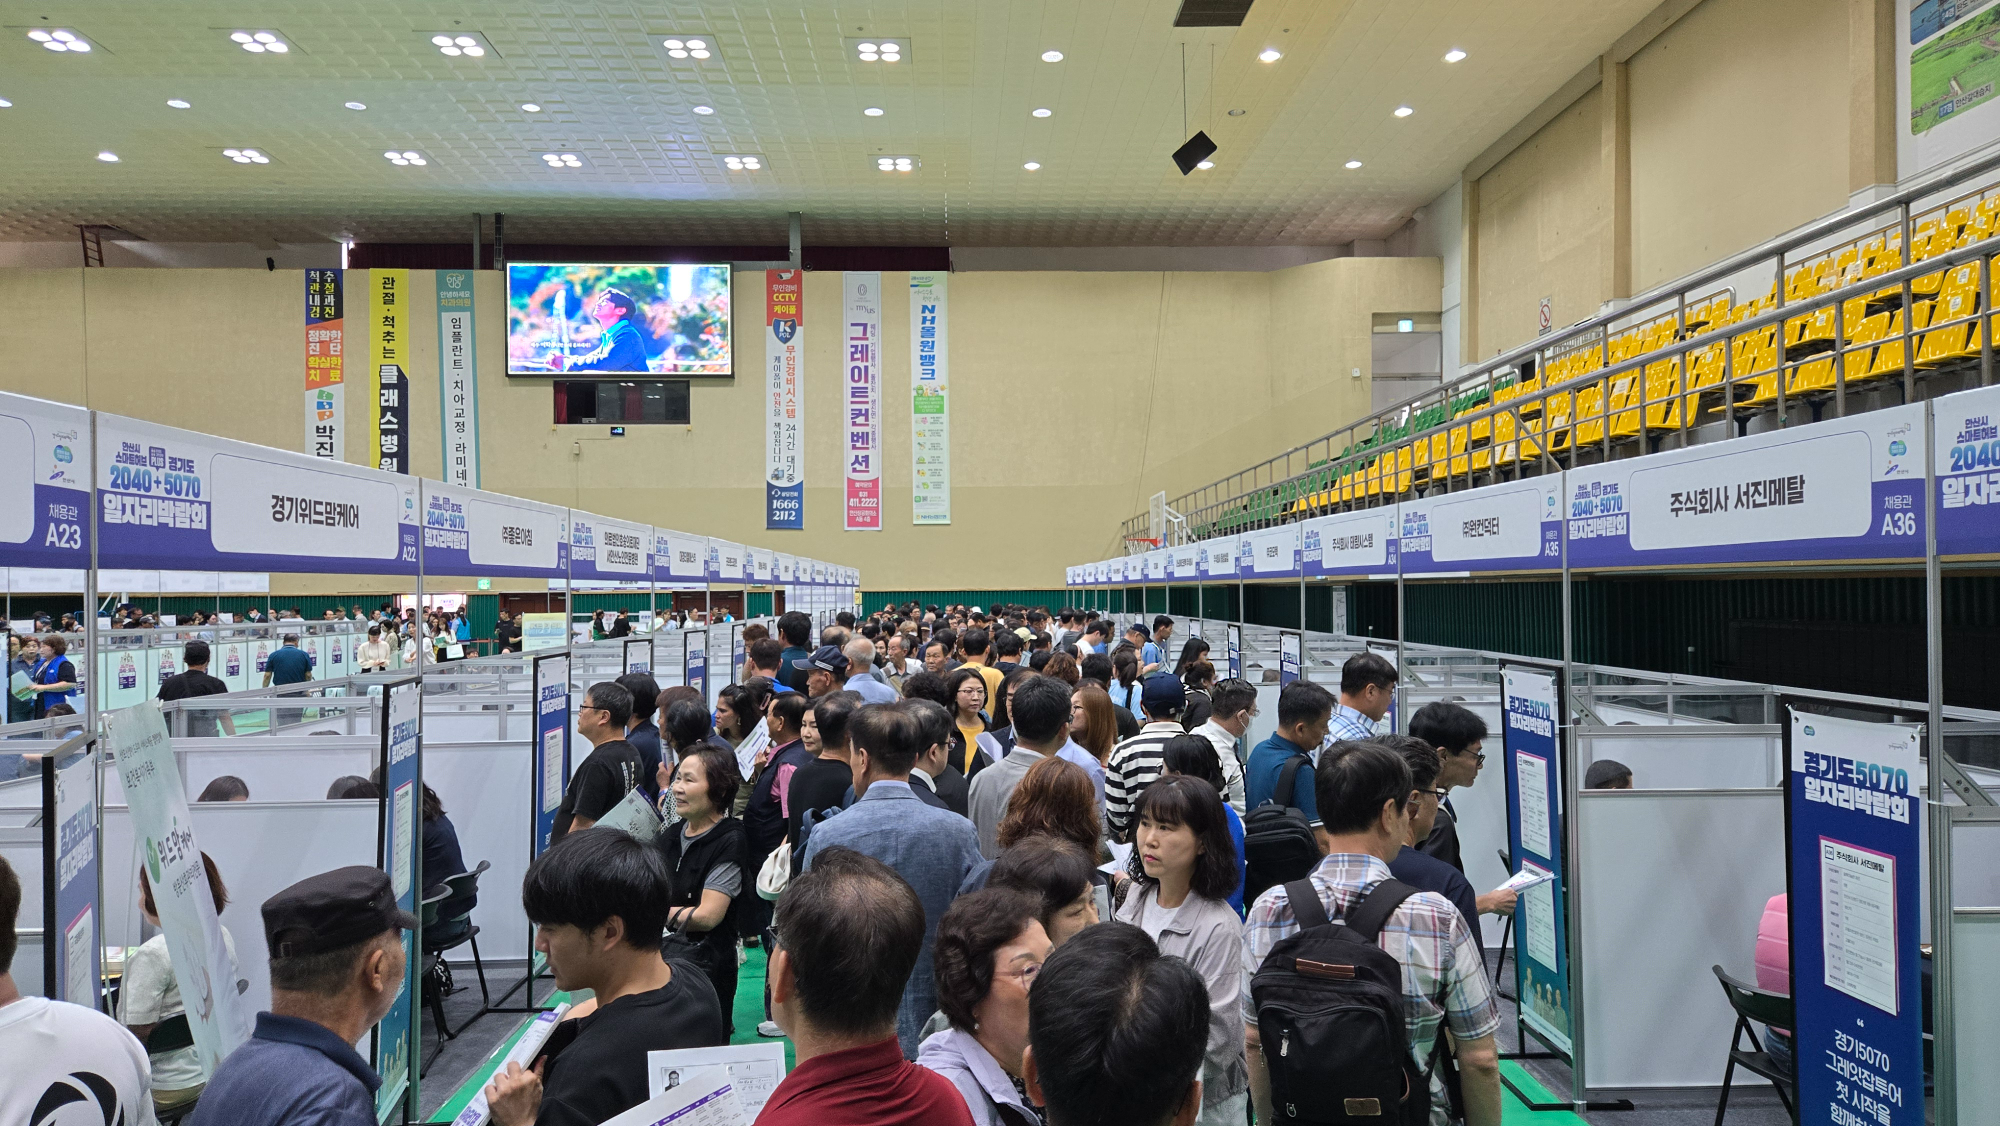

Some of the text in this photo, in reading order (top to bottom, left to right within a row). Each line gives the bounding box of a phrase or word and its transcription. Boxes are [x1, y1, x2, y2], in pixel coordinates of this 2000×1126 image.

[772, 284, 798, 293] 무인경비
[773, 293, 797, 302] CCTV
[308, 330, 342, 343] 정확한
[308, 356, 342, 369] 확실한
[850, 322, 870, 474] 그레이트컨벤션
[785, 345, 797, 483] 무인경비시스템 24시간 대기중
[1964, 415, 1989, 430] 안산시
[315, 424, 336, 461] 박진
[1956, 424, 1998, 445] 스마트허브
[121, 440, 141, 453] 안산시
[115, 452, 148, 469] 스마트허브
[168, 456, 195, 474] 경기도
[1602, 482, 1619, 496] 경기도
[1670, 473, 1806, 518] 주식회사 서진메탈
[48, 503, 78, 522] 채용관
[103, 492, 208, 530] 일자리박람회
[270, 493, 360, 530] 경기위드맘케어
[772, 499, 799, 510] 1666
[1884, 494, 1913, 510] 채용관
[772, 510, 797, 521] 2112
[1568, 513, 1628, 540] 일자리박람회
[1880, 512, 1916, 536] A36
[45, 522, 82, 550] A23
[402, 545, 417, 562] A22
[1544, 542, 1559, 557] A35
[1509, 711, 1552, 738] 일자리박람회
[1803, 750, 1909, 796] 경기도5070
[1803, 776, 1910, 825] 일자리박람회
[1836, 850, 1859, 866] 주식회사
[1834, 1029, 1890, 1073] 경기5070
[1825, 1050, 1902, 1108] 그레잇잡투어
[1835, 1080, 1850, 1104] 첫
